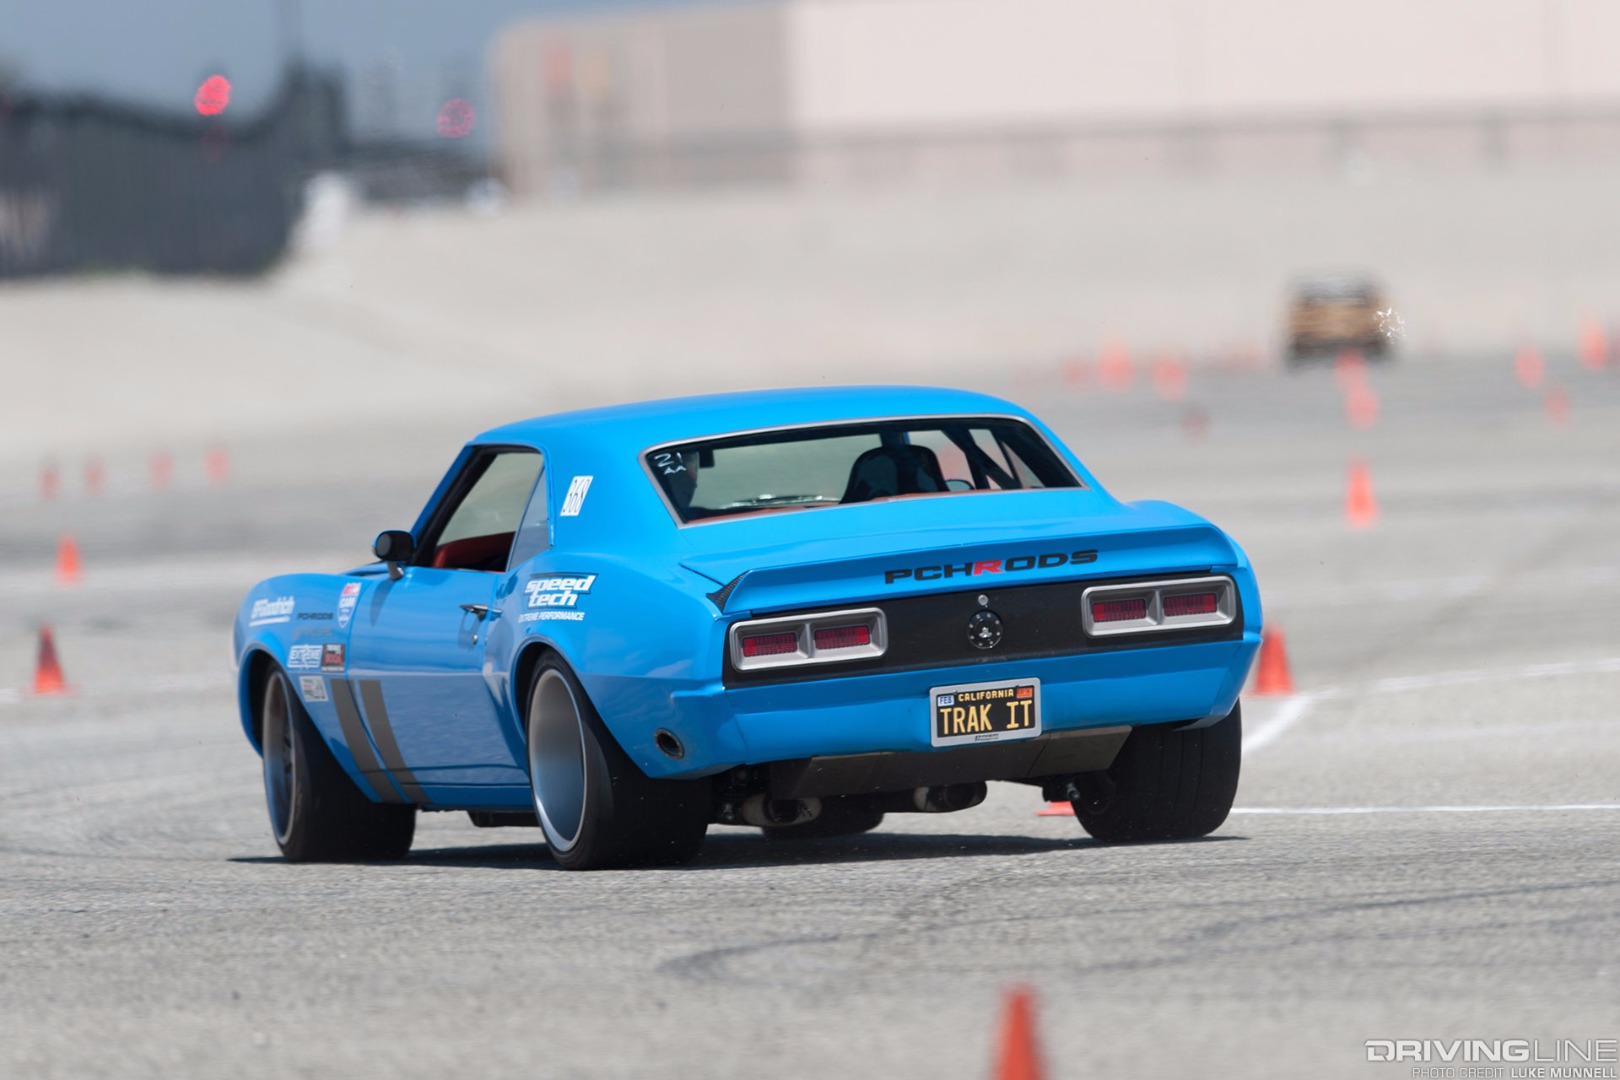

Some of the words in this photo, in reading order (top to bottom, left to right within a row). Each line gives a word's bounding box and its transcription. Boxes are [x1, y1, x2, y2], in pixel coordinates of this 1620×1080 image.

[885, 549, 1099, 585] PCHRODS
[524, 575, 596, 594] speed
[528, 590, 578, 608] tech
[957, 688, 1015, 702] CALIFORNIA
[939, 703, 993, 735] TRAK
[1005, 699, 1033, 729] IT
